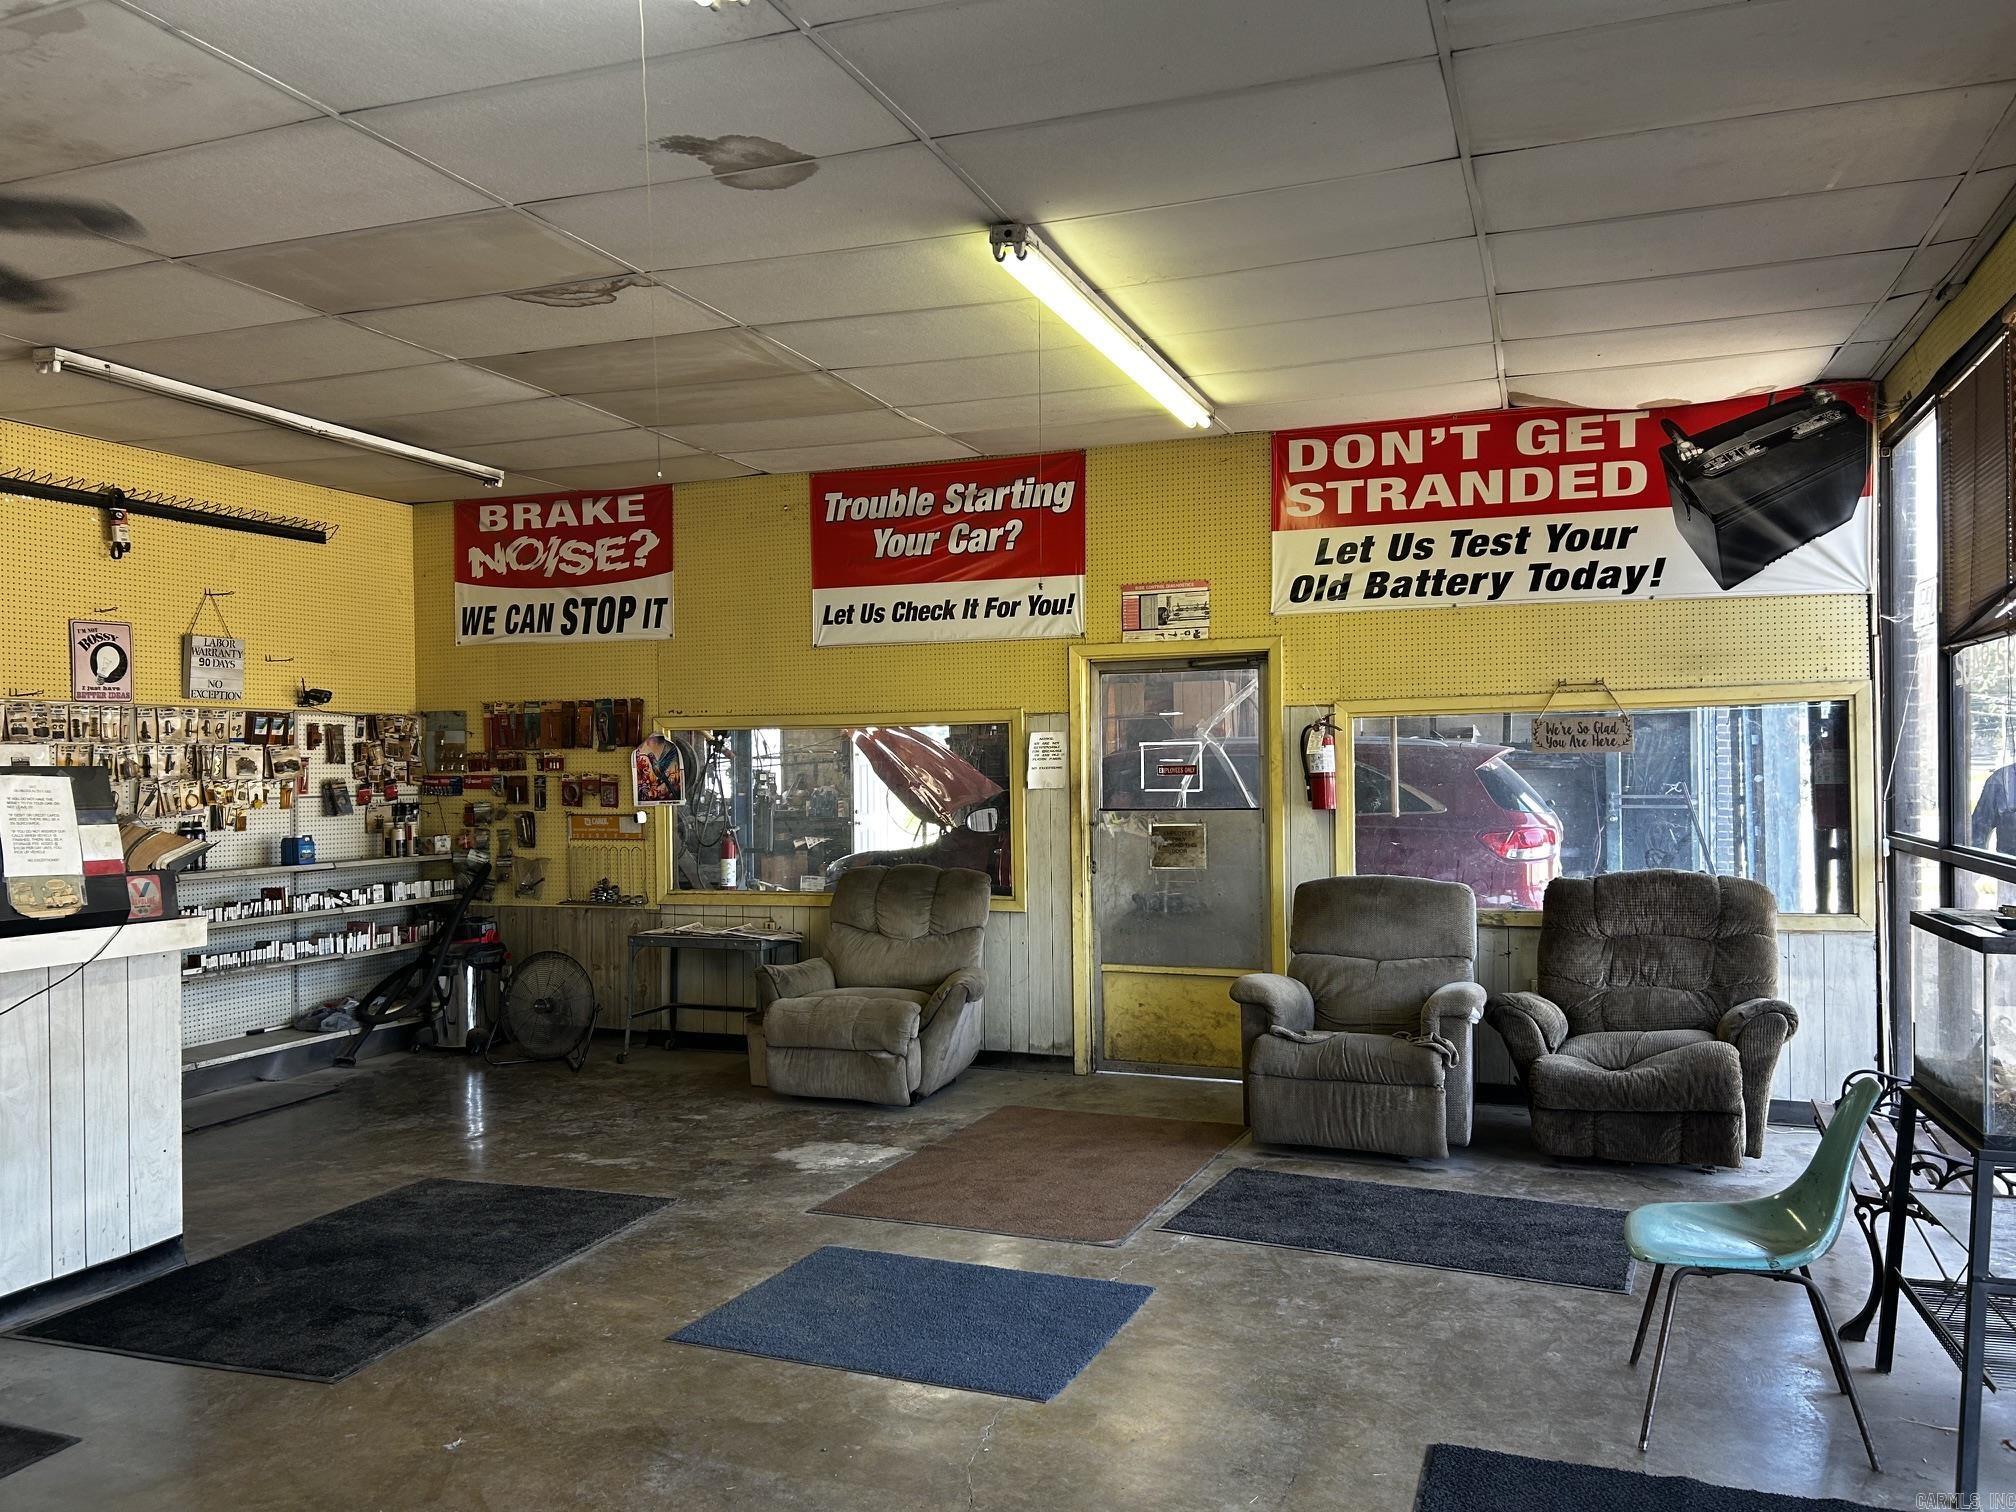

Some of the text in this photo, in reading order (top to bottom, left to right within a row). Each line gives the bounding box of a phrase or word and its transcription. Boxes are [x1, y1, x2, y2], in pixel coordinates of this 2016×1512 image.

[1287, 411, 1650, 474] DON'T GET
[824, 477, 1075, 522] Trouble Starting
[1286, 460, 1648, 518] STRANDED
[479, 493, 645, 532] BRAKE
[468, 529, 660, 578] NOISE?
[873, 519, 1023, 558] Your Car?
[1315, 522, 1640, 567] Let Us Test Your
[1289, 558, 1667, 603] Old Battery Today!
[461, 595, 668, 636] WE CAN STOP IT
[822, 593, 1075, 626] Let Us Check It For You!
[77, 632, 119, 652] BOSSY
[191, 646, 243, 659] WARRANTY
[204, 637, 236, 648] LABOR
[198, 657, 235, 669] 90 DAYS
[76, 691, 131, 699] BETTER IDEAS
[191, 689, 242, 701] EXCEPTION
[207, 679, 223, 689] NO
[1545, 720, 1620, 736] We're So Glad
[1545, 734, 1567, 749] You
[1569, 734, 1589, 748] Are
